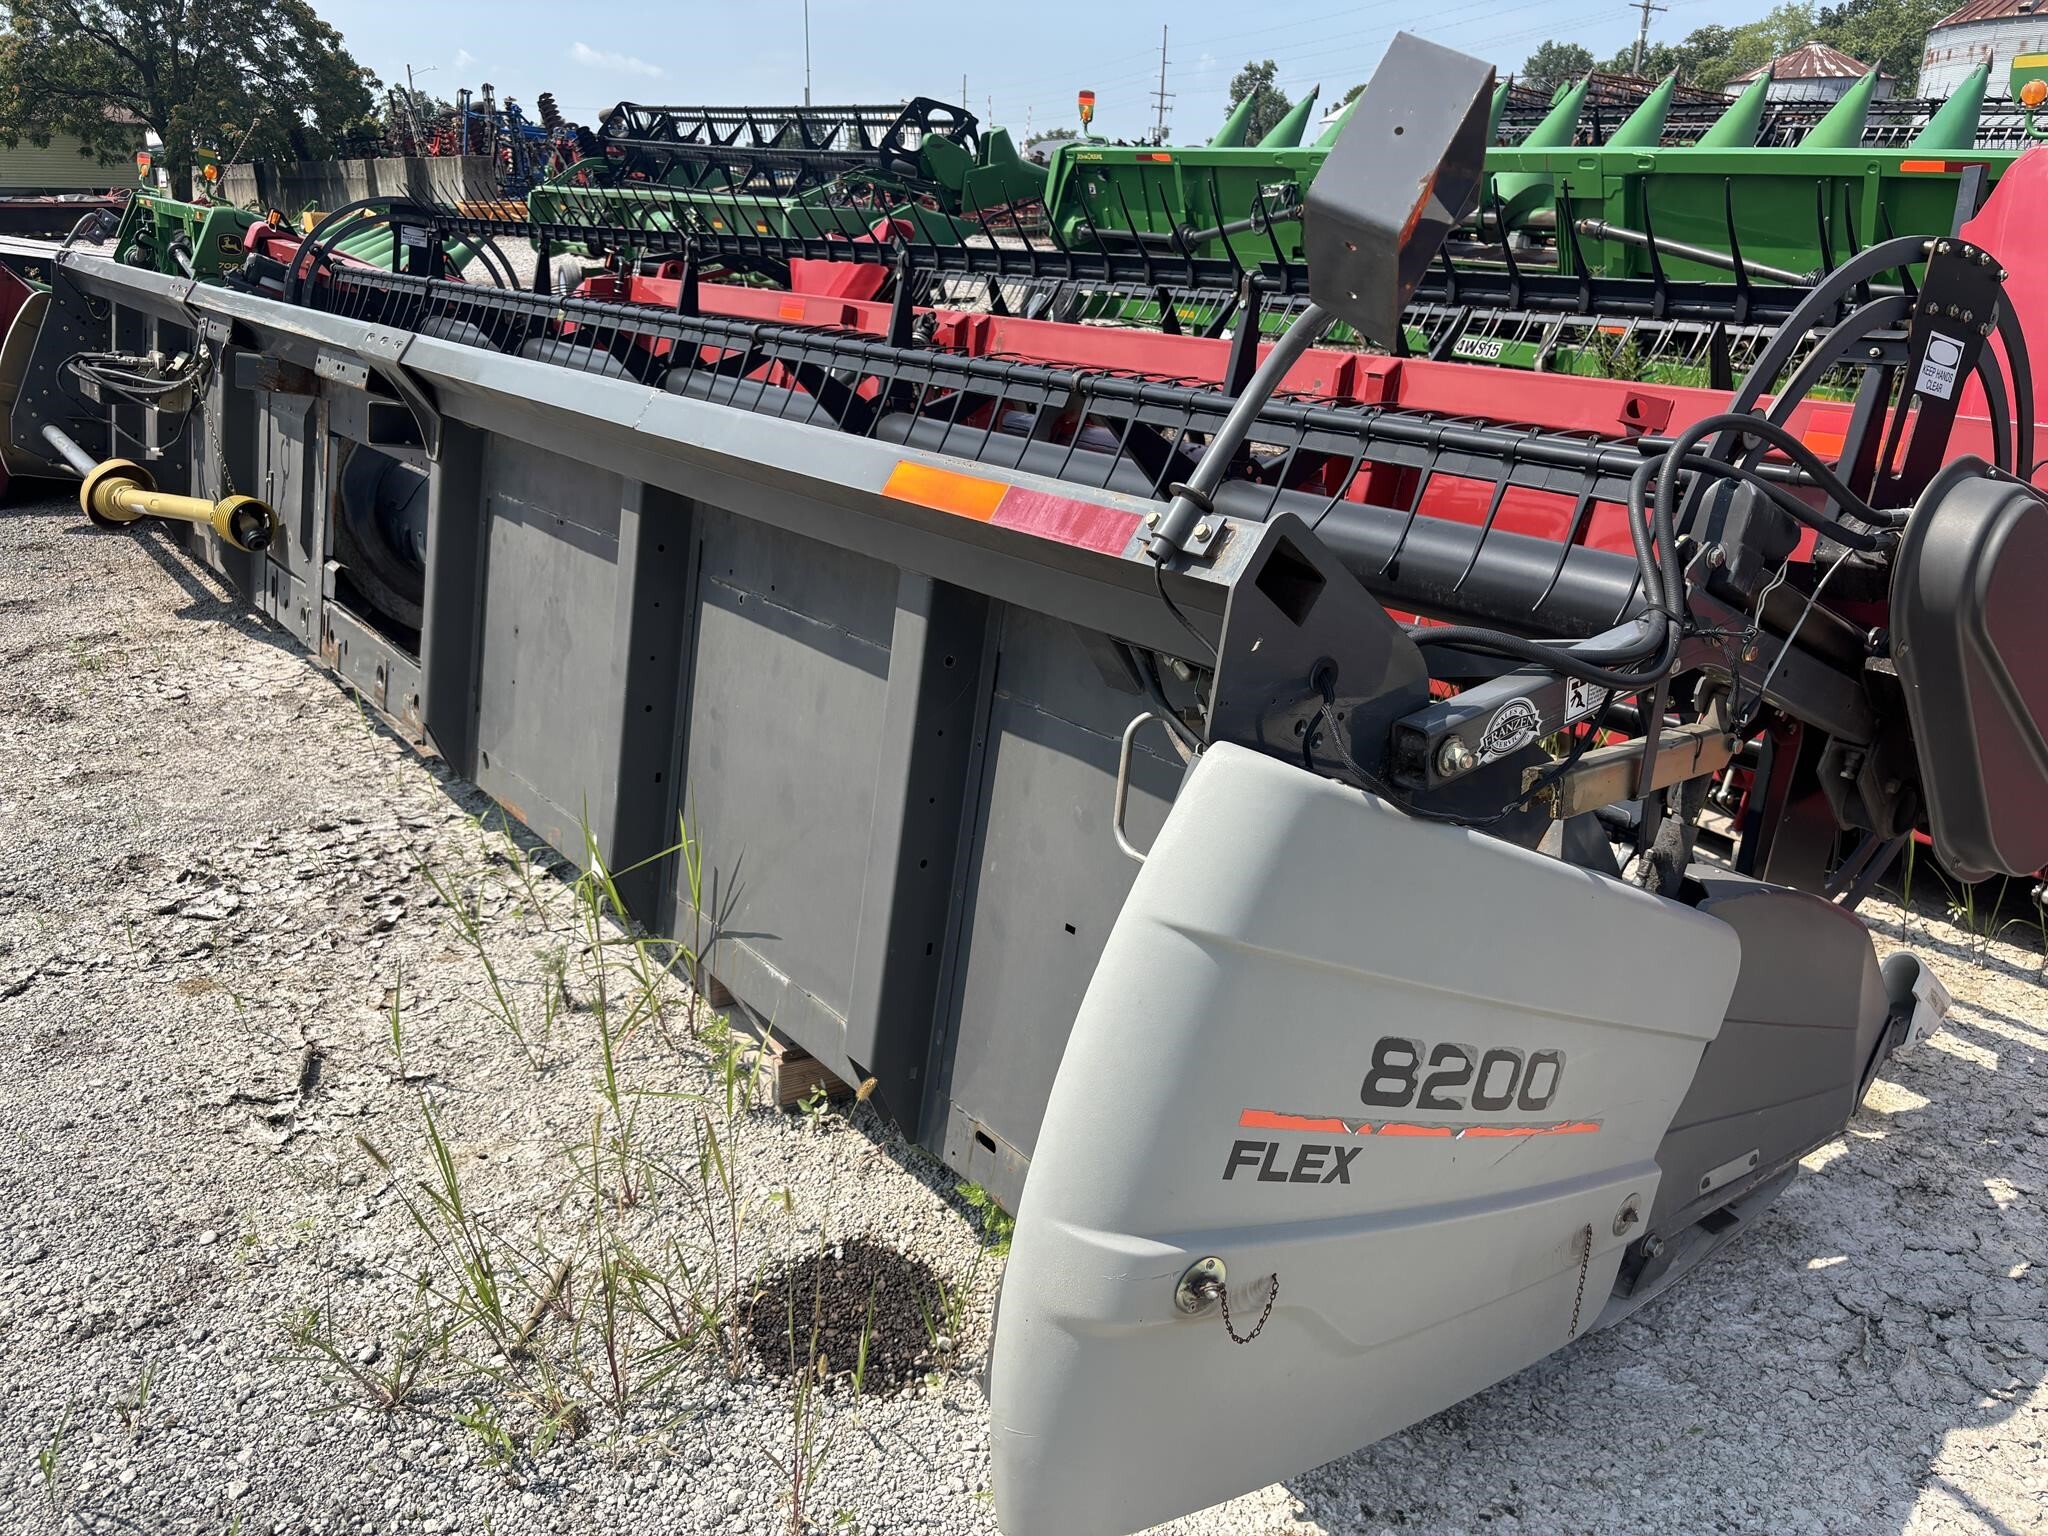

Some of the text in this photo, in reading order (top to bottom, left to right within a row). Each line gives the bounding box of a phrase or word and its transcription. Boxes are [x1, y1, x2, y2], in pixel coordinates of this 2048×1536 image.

[1455, 339, 1502, 358] 4WS15
[1922, 364, 1953, 383] KEEP HANDS
[1926, 379, 1943, 393] CLEAR
[1484, 714, 1535, 750] FRANZEN
[1360, 1036, 1566, 1111] 8200
[1222, 1140, 1363, 1185] FLEX
